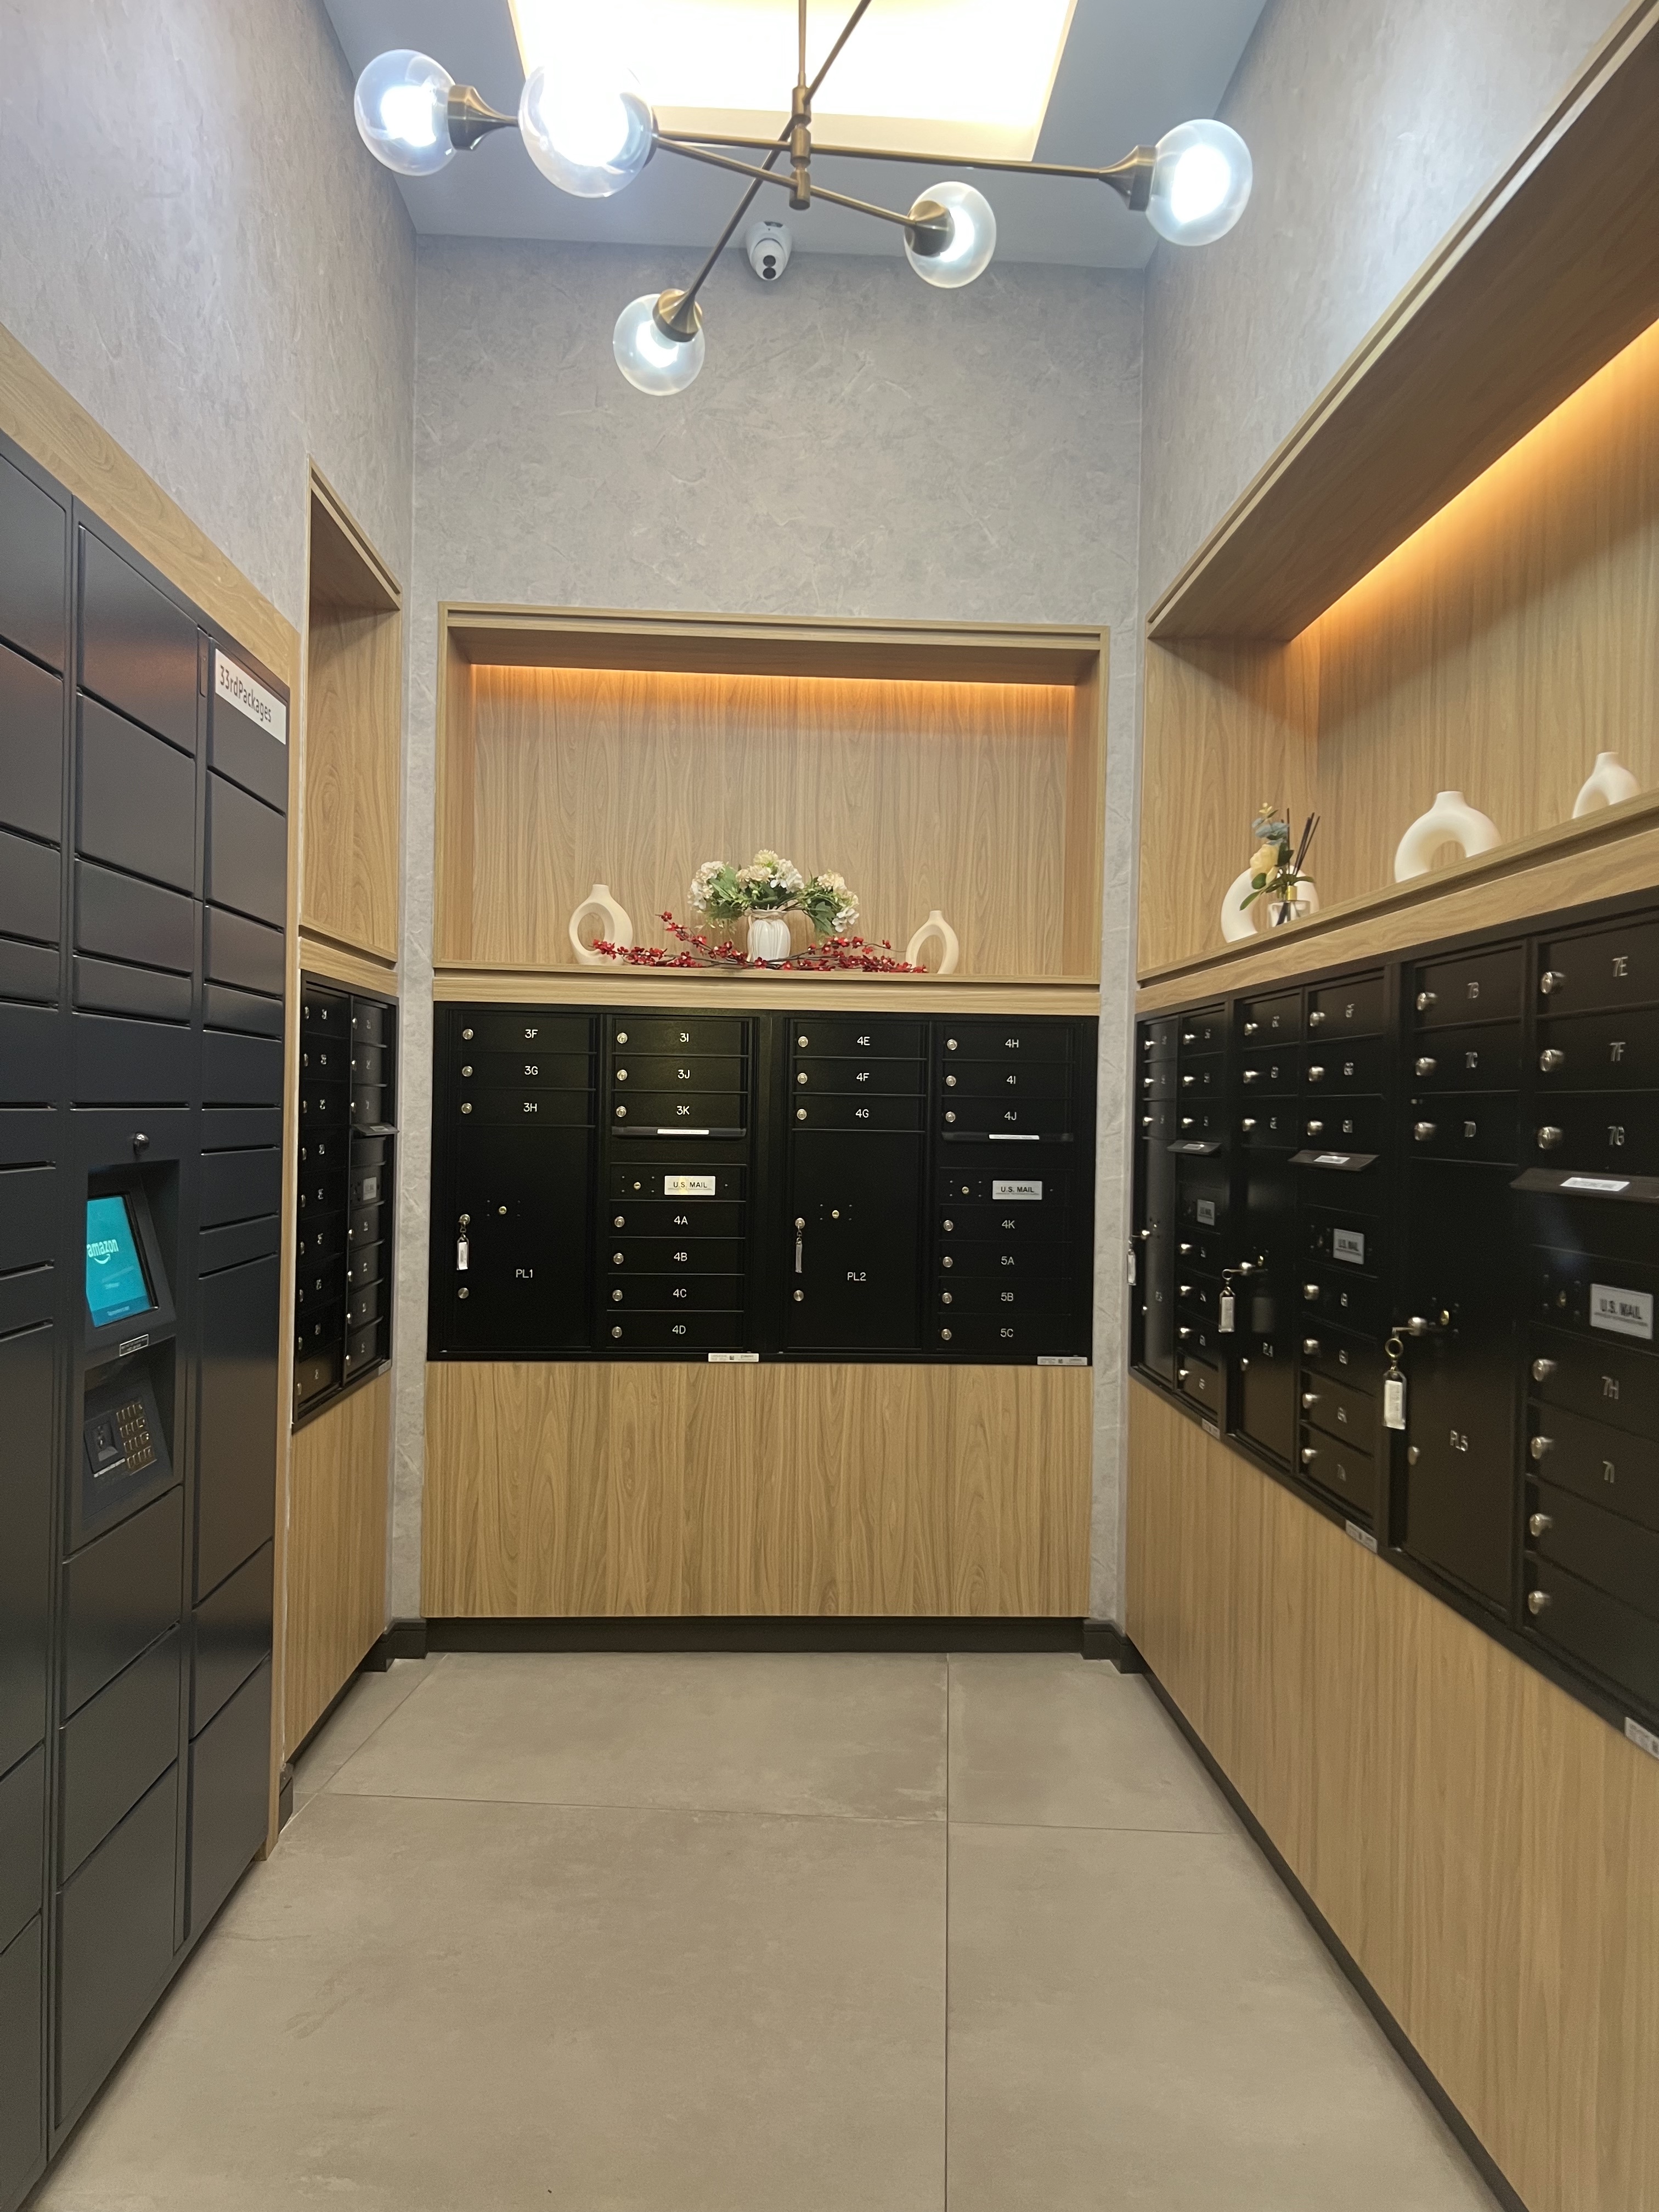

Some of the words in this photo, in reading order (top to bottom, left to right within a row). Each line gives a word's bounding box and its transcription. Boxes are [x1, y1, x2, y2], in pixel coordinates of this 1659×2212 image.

[220, 664, 272, 723] 33rdPackages
[1612, 956, 1628, 977] 7E
[524, 1029, 538, 1039] 3F
[679, 1032, 689, 1042] 3I
[856, 1036, 871, 1046] 4E
[1005, 1039, 1019, 1048] 4H
[1609, 1041, 1626, 1062] 7F
[524, 1065, 538, 1075] 3G
[678, 1069, 690, 1079] 3J
[856, 1073, 870, 1082] 4F
[1006, 1075, 1016, 1085] 4I
[523, 1102, 538, 1112] 3H
[676, 1105, 690, 1115] 3K
[855, 1109, 869, 1118] 4G
[1004, 1111, 1017, 1121] 4J
[1607, 1126, 1625, 1146] 7G
[673, 1215, 689, 1225] 4A
[1001, 1220, 1015, 1229] 4K
[87, 1239, 119, 1257] amazon
[673, 1252, 687, 1262] 4B
[1001, 1256, 1015, 1265] 5A
[516, 1268, 533, 1278] PL1
[847, 1272, 866, 1282] PL2
[673, 1288, 687, 1298] 4C
[1000, 1292, 1014, 1302] 5B
[1619, 1302, 1643, 1320] MAIL
[672, 1325, 686, 1335] 4D
[1000, 1328, 1014, 1338] 5C
[1601, 1375, 1619, 1400] 7H
